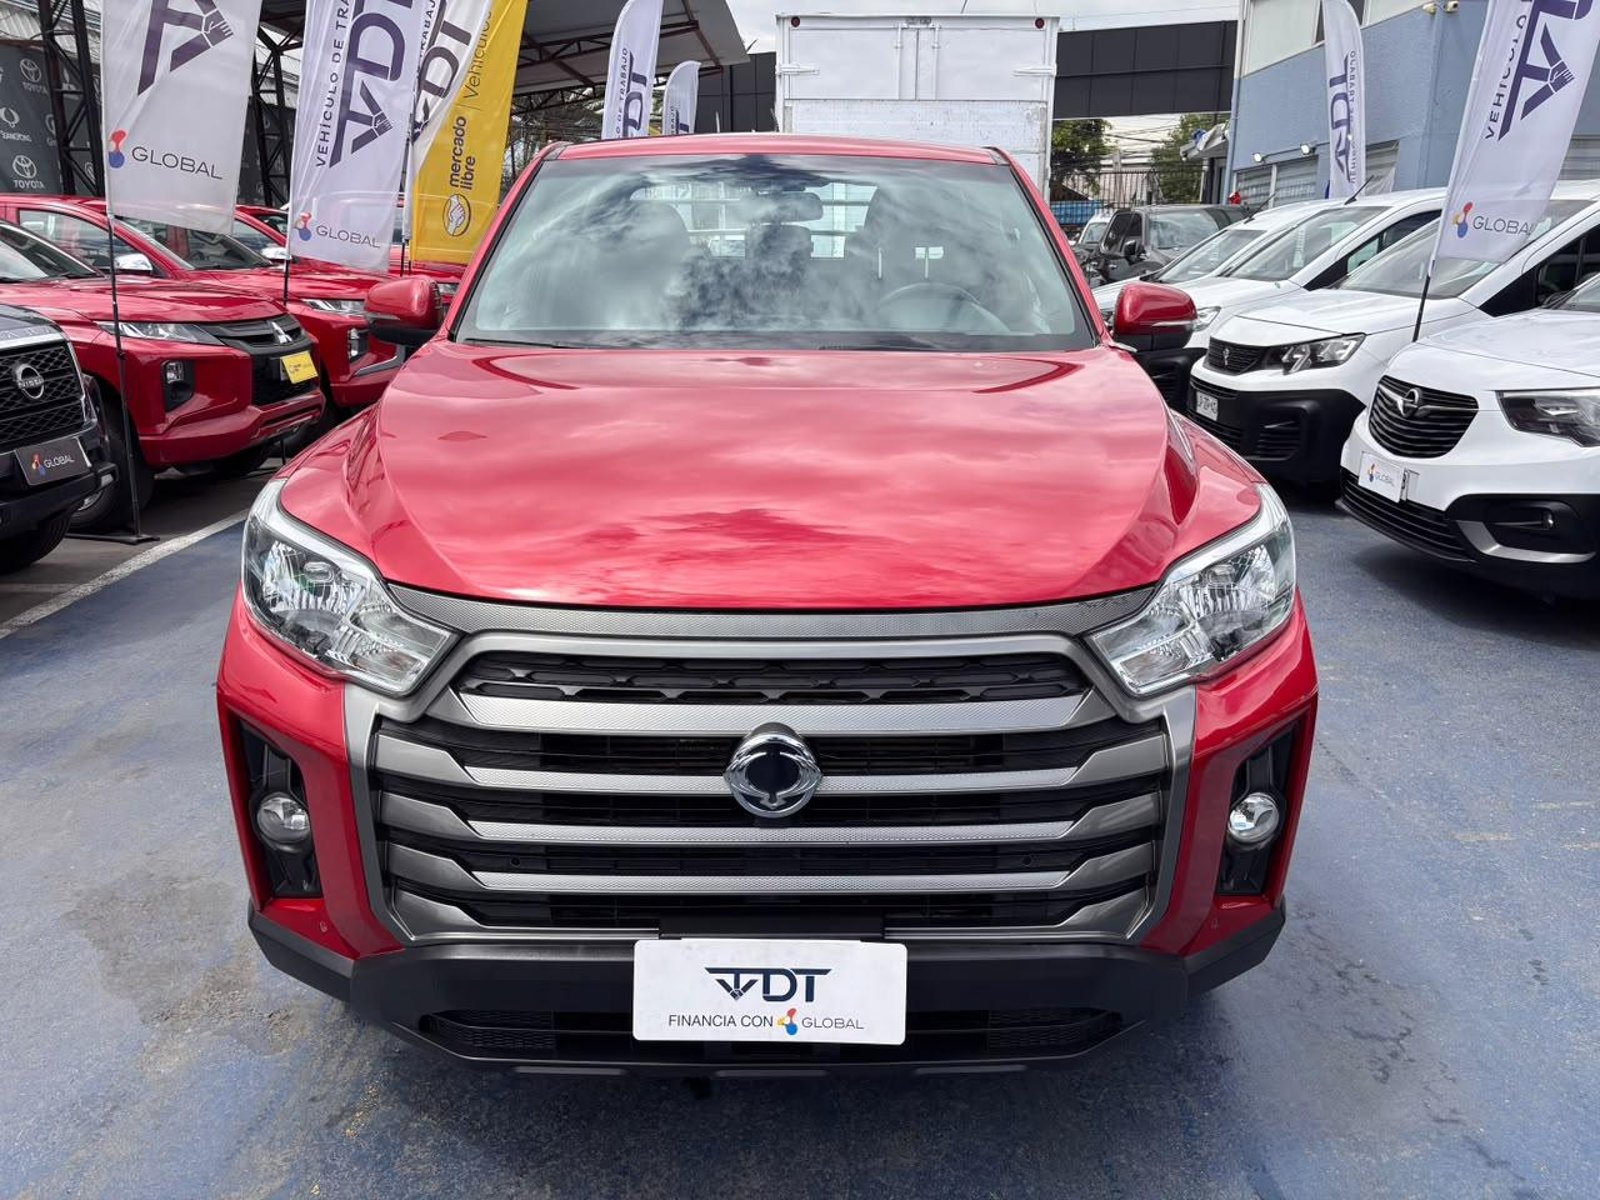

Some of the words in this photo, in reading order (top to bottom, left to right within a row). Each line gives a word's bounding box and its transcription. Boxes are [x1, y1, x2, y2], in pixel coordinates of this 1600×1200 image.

[331, 39, 345, 64] DE
[131, 146, 223, 180] GLOBAL
[450, 116, 467, 188] mercado
[14, 180, 45, 189] TOYOTA
[460, 156, 476, 190] libre
[316, 225, 381, 249] GLOBAL
[43, 455, 75, 468] GLOBAL
[668, 1014, 737, 1027] FINANCIA
[740, 1014, 773, 1027] CON
[801, 1017, 865, 1030] GLOBAL
